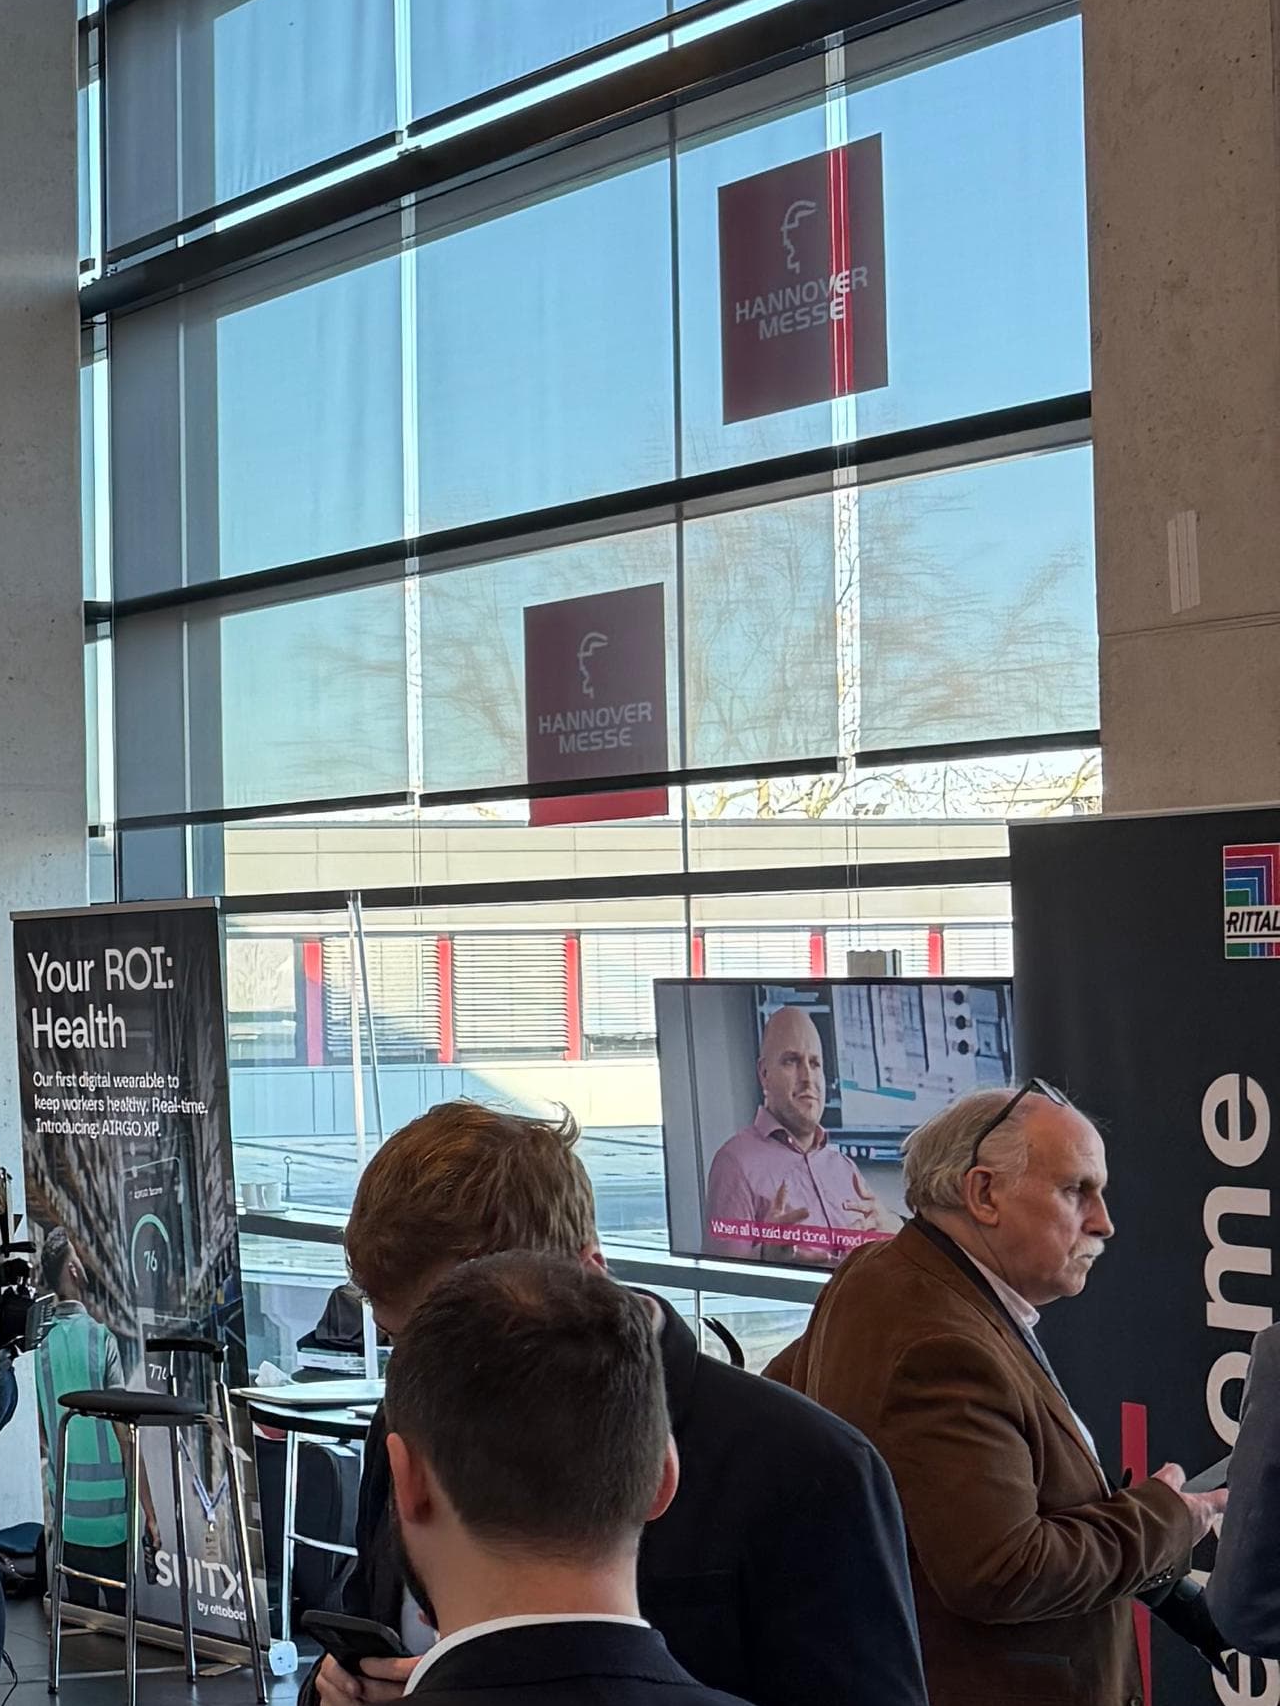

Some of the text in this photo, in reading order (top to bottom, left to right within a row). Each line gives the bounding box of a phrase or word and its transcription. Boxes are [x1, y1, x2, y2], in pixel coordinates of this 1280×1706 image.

[735, 266, 868, 324] HANNOVER
[759, 297, 844, 340] MESSE
[538, 701, 652, 734] HANNOVER
[559, 727, 633, 754] MESSE
[1226, 910, 1280, 933] RITTAL
[27, 946, 174, 992] Your ROI:
[31, 1003, 127, 1048] Health
[32, 1071, 180, 1091] Our first digital wearable to
[34, 1094, 209, 1116] keep workers healthy. Real-time.
[36, 1118, 162, 1140] Introducing: AIRGO XP.
[143, 1250, 158, 1272] 76
[197, 1598, 209, 1616] by
